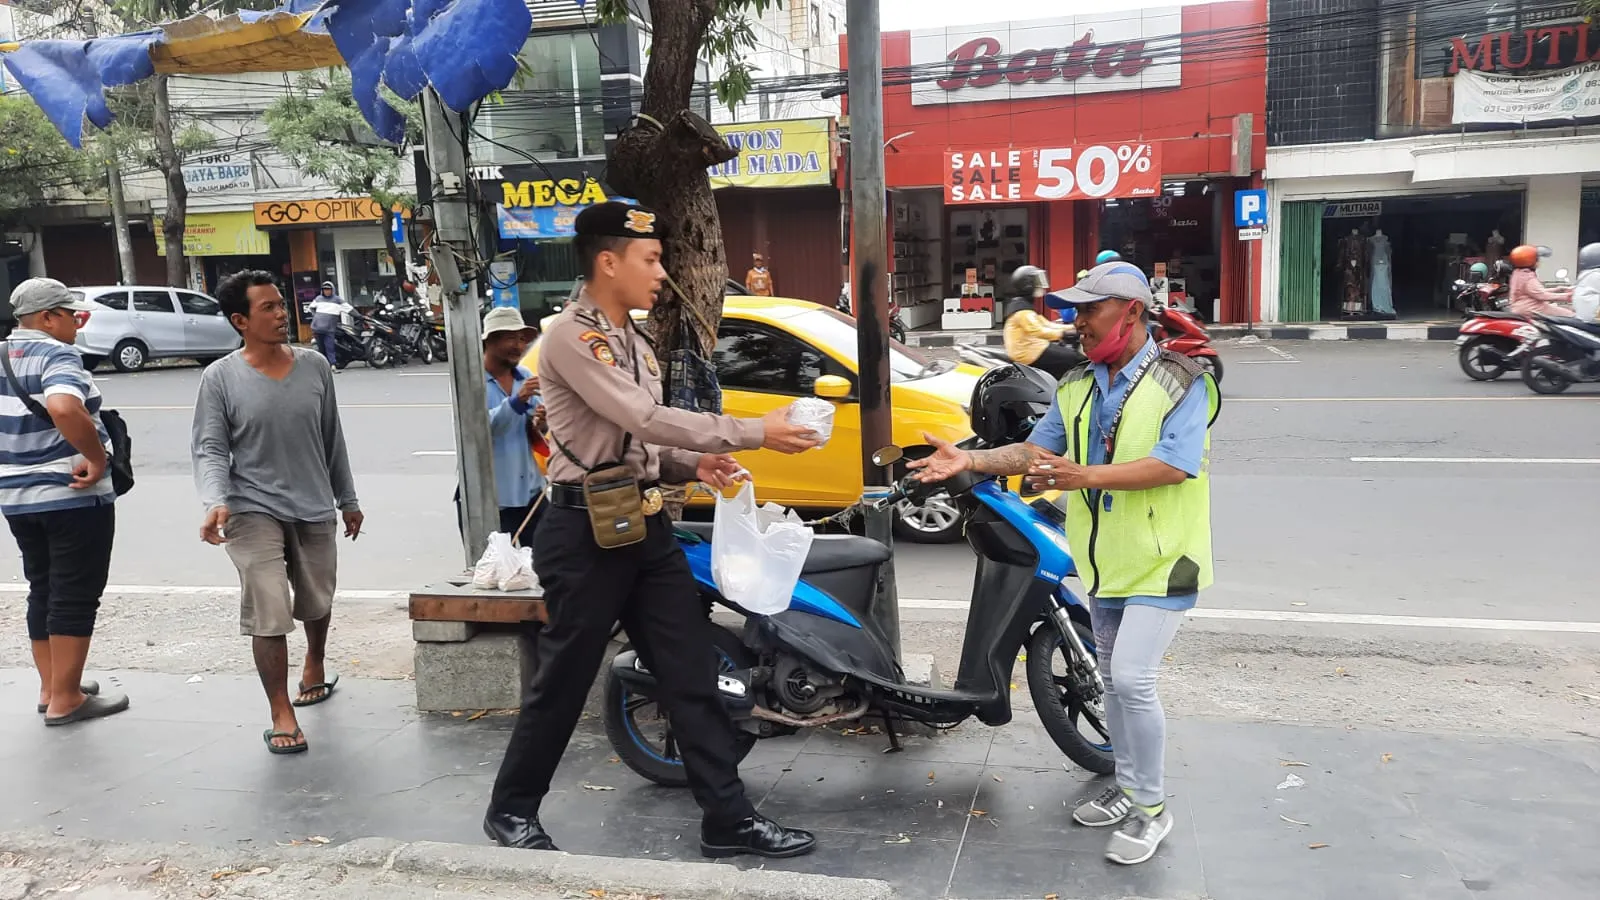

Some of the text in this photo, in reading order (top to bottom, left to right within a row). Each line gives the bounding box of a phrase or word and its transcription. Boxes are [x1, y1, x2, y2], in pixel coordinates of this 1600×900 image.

[936, 27, 1152, 91] Bata
[1448, 23, 1600, 74] MUTI
[726, 130, 782, 151] WON
[748, 151, 821, 175] MADA
[951, 151, 1020, 169] SALE
[218, 164, 250, 181] BARU
[469, 166, 505, 180] TIK
[951, 168, 1020, 185] SALE
[1034, 144, 1150, 199] 50%
[501, 177, 608, 209] MEGA
[951, 184, 1020, 201] SALE
[265, 202, 306, 223] GO
[315, 200, 366, 221] OPTIK
[1242, 195, 1260, 221] P
[1340, 202, 1380, 213] MUTIARA
